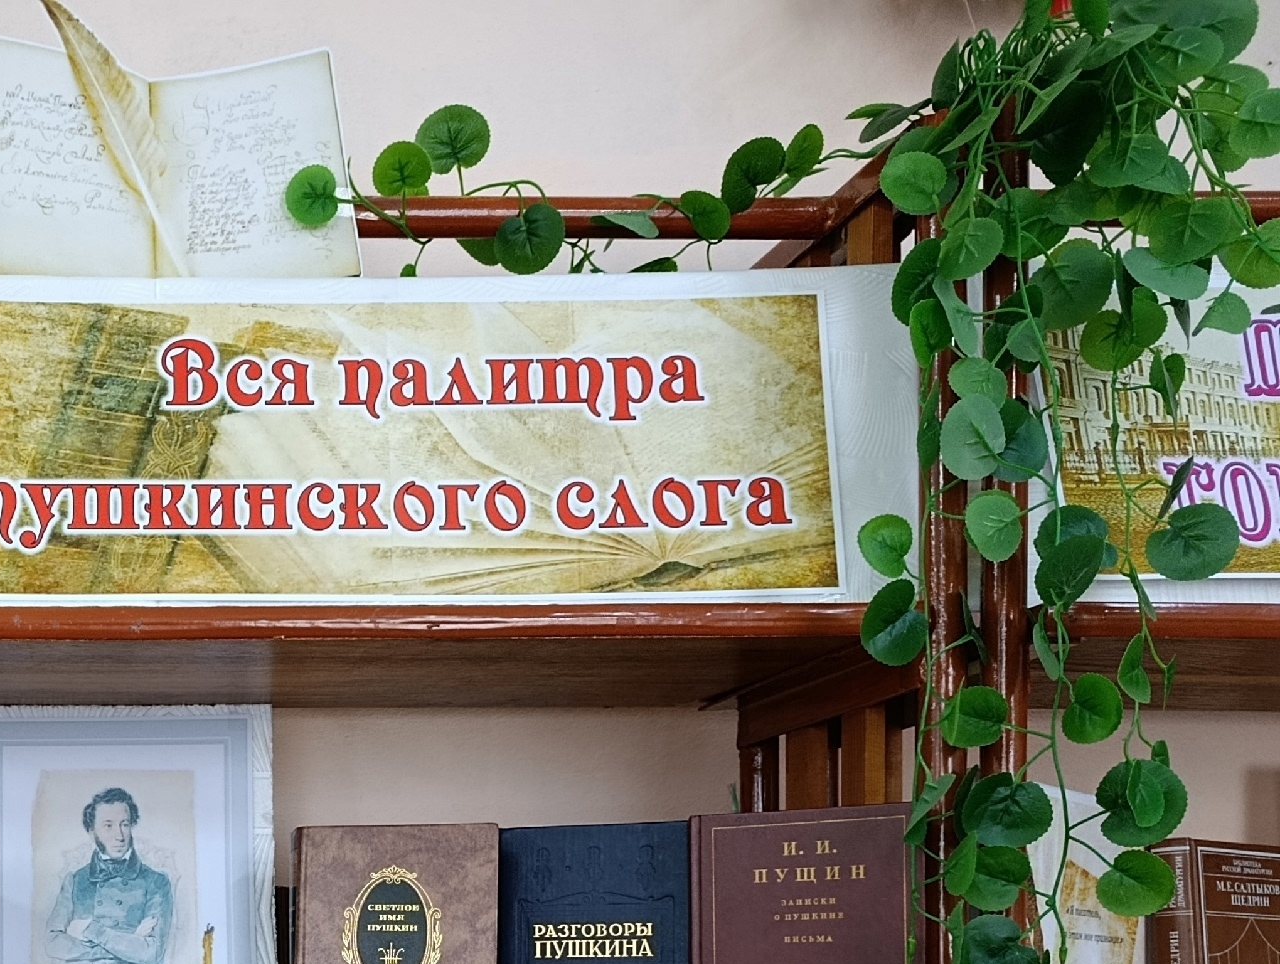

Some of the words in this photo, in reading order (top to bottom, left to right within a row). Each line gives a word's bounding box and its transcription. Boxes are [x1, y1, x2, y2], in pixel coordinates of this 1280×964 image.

[160, 337, 315, 408] Вся
[337, 351, 706, 422] палитра
[555, 475, 794, 532] слога
[781, 841, 805, 857] И.
[816, 840, 838, 854] И.
[752, 863, 867, 885] ПУЩИН
[781, 897, 837, 907] ЗАПИСКИ
[1230, 893, 1270, 907] ЩЕДРИН
[366, 903, 421, 912] СВЕТЛОЕ
[378, 913, 405, 922] ИМЯ
[784, 911, 845, 921] ПУШКИНЕ
[366, 923, 418, 932] ПУШКИН
[532, 922, 654, 939] РАЗГОВОРЫ
[783, 934, 834, 944] ПИСЬМА
[533, 938, 655, 960] ПУШКИНА
